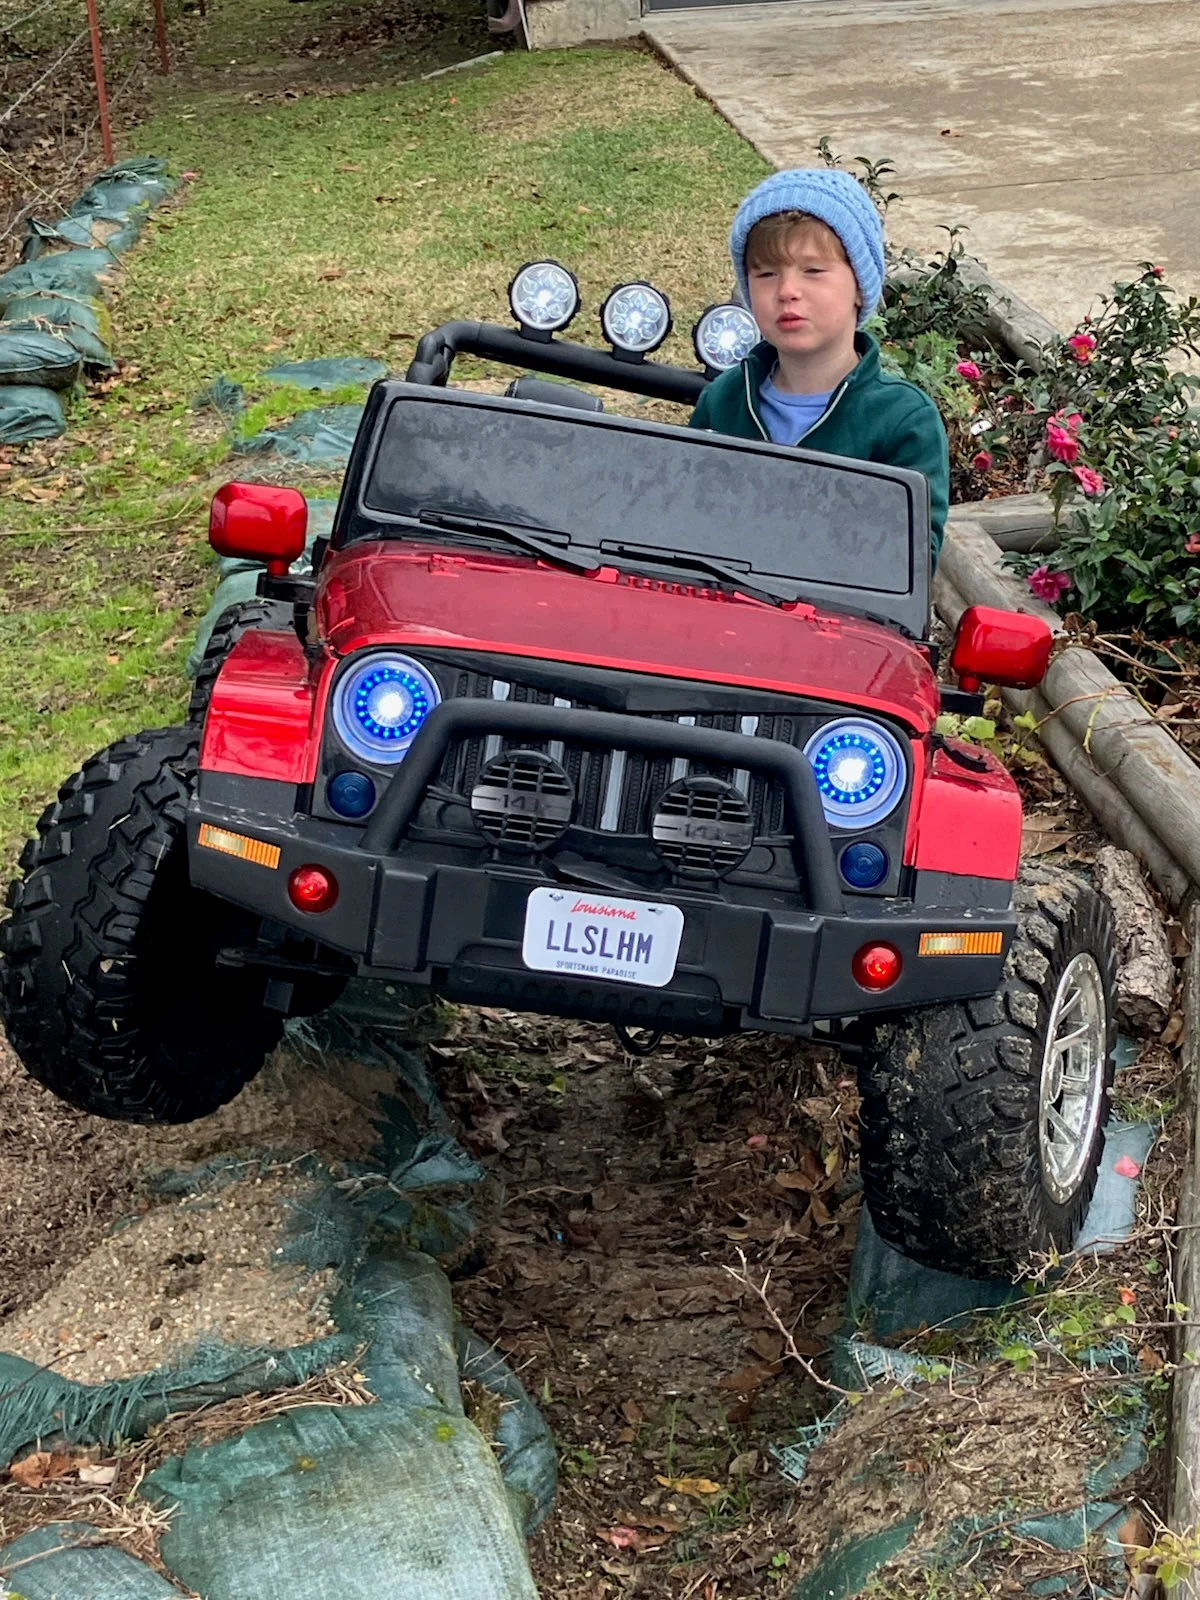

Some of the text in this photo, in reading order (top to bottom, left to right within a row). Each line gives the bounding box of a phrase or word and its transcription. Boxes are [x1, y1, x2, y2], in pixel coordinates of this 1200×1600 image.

[571, 898, 637, 920] Louisiana
[546, 919, 653, 964] LLSLHM
[602, 966, 638, 980] PARADISE
